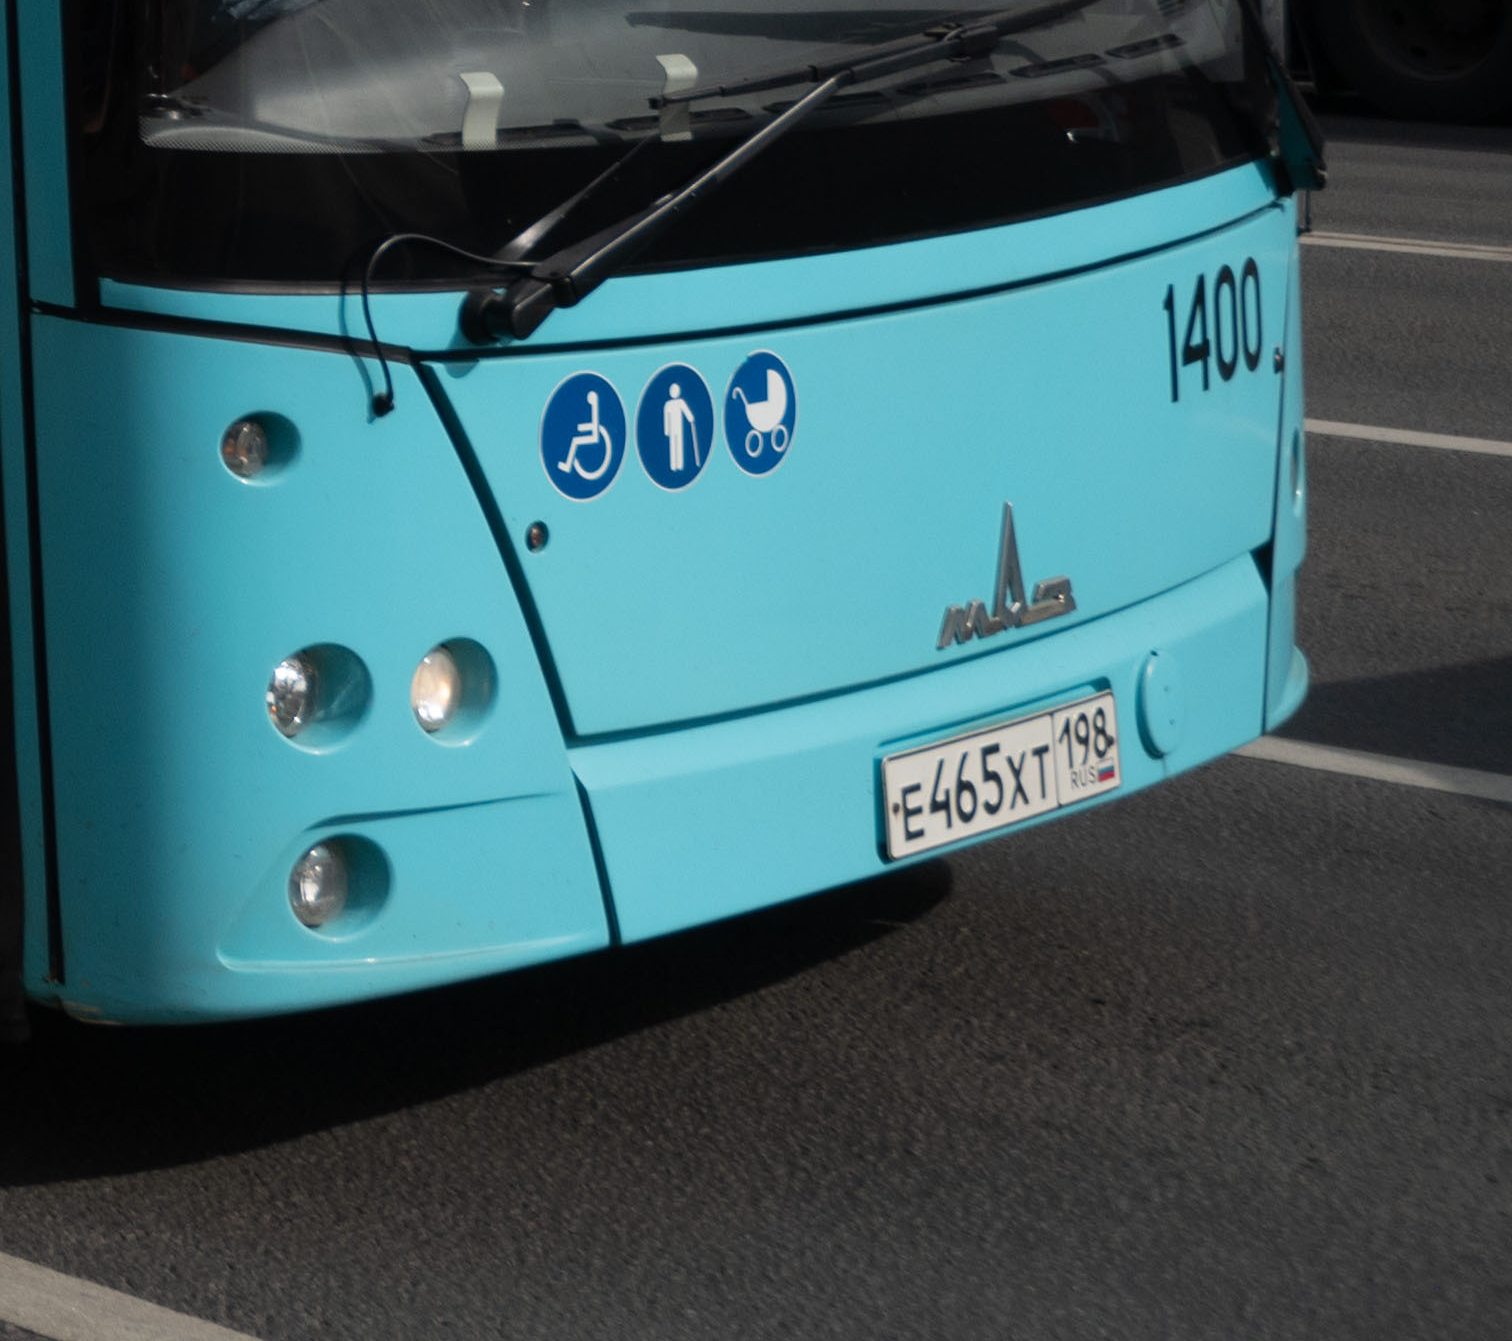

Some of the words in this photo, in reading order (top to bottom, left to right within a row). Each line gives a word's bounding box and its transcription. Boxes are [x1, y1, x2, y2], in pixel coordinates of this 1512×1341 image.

[1163, 256, 1262, 403] 1400
[1058, 707, 1108, 769] 198
[1071, 765, 1096, 790] RUS
